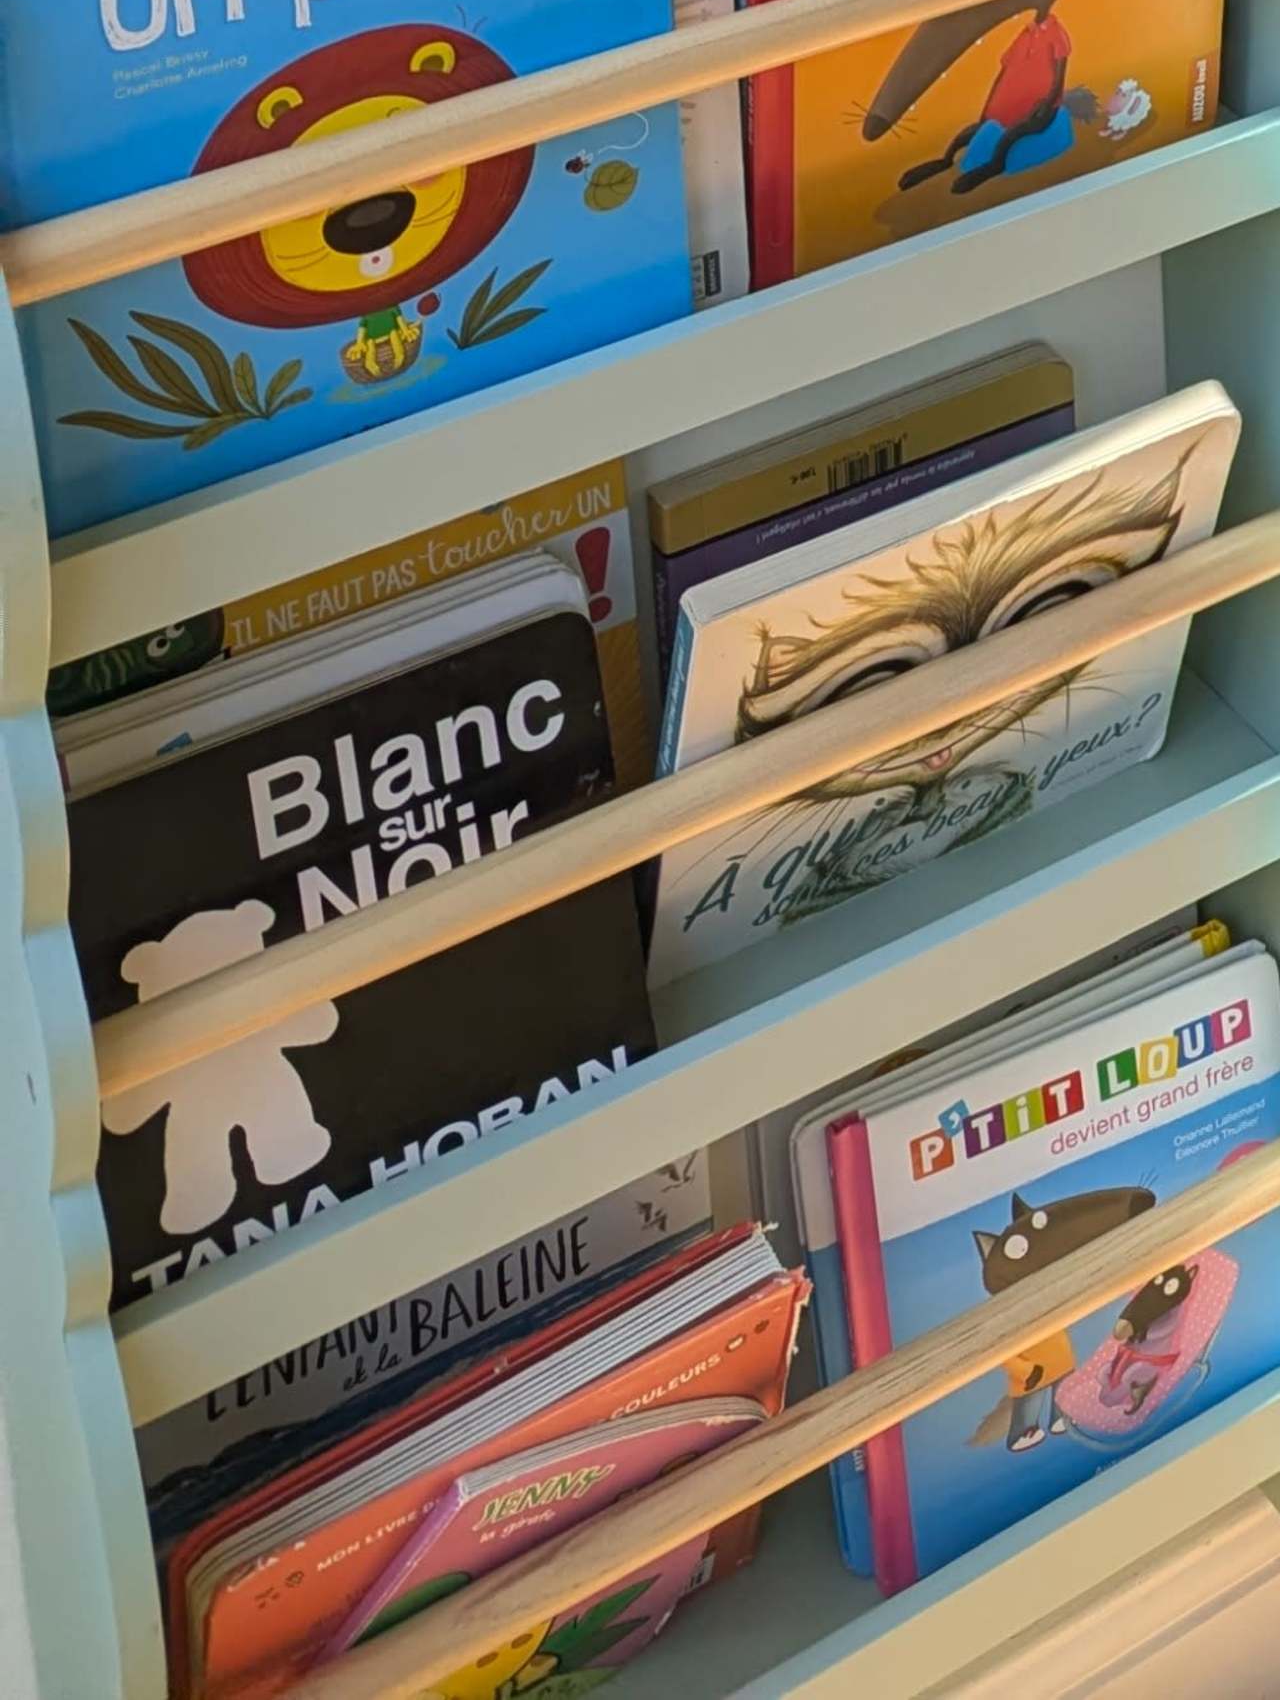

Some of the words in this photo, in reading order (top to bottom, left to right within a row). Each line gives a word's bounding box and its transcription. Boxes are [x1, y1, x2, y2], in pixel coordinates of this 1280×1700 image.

[229, 619, 260, 649] IL
[266, 602, 300, 637] NE
[307, 575, 366, 623] FAUT
[371, 559, 417, 599] PAS
[419, 504, 574, 577] toucher
[577, 483, 612, 518] UN
[247, 678, 564, 859] Blanc
[378, 793, 452, 852] sur
[852, 833, 912, 881] ces
[923, 765, 1037, 841] beaux
[297, 800, 529, 932] Noir
[763, 797, 888, 903] qui
[1050, 1103, 1132, 1156] devient
[1137, 1079, 1199, 1129] grand
[1203, 1052, 1254, 1101] frère
[1101, 1003, 1249, 1099] LOUP
[409, 1216, 592, 1358] BALEINE
[343, 1358, 368, 1393] et
[374, 1343, 402, 1376] la
[317, 1542, 361, 1572] MON
[365, 1511, 418, 1545] LIVRE
[610, 1352, 722, 1422] COULEURS
[474, 1463, 617, 1531] JENNY
